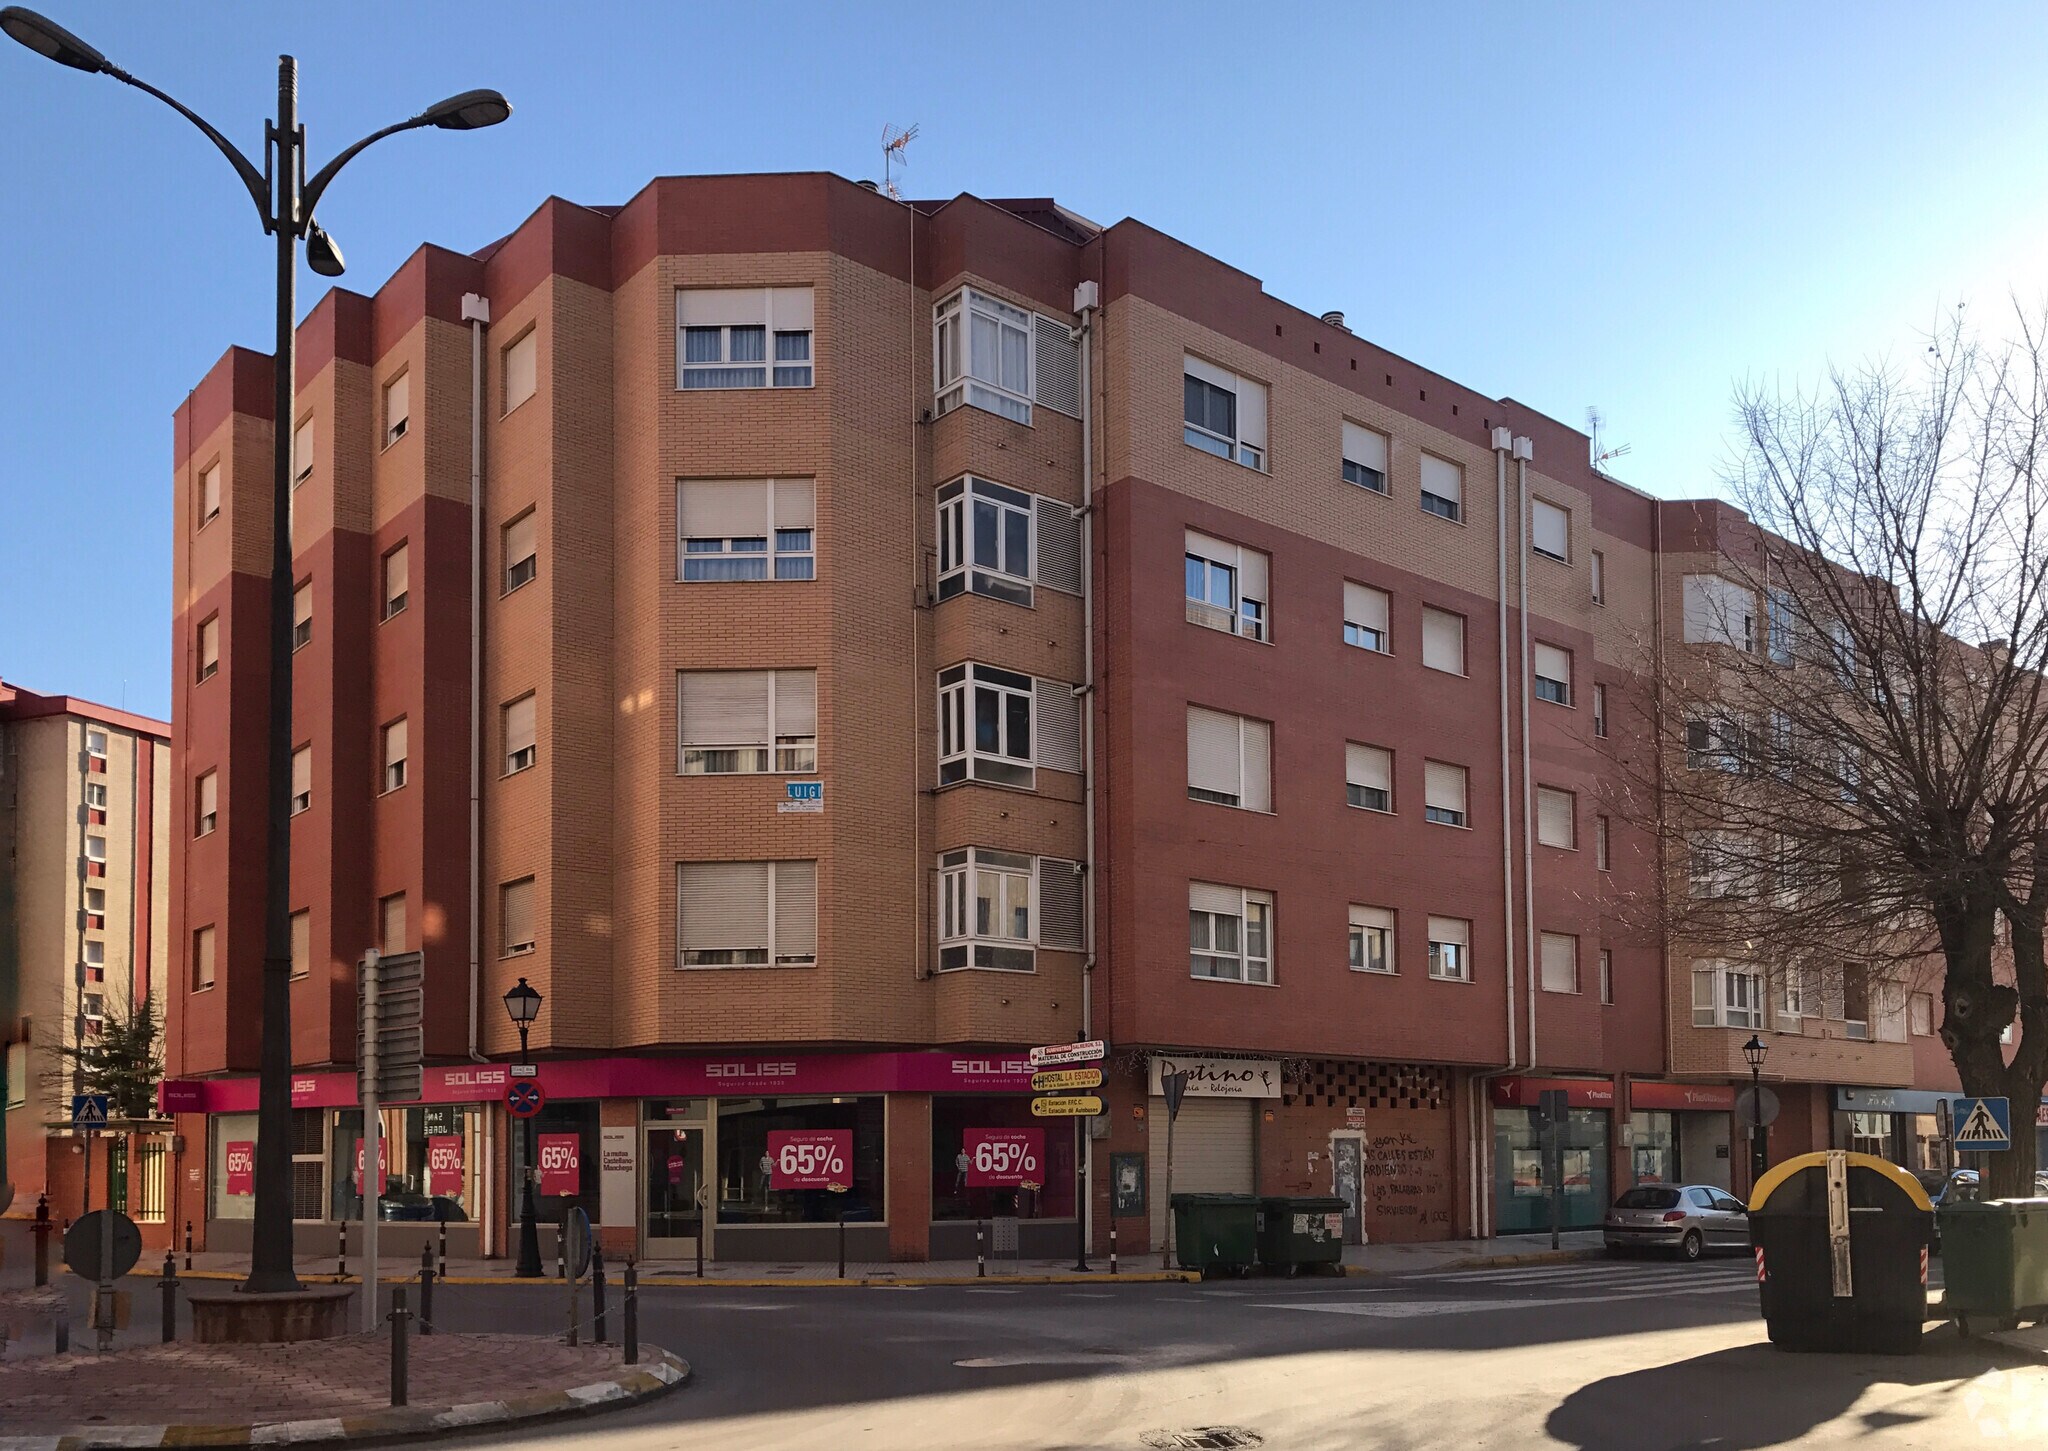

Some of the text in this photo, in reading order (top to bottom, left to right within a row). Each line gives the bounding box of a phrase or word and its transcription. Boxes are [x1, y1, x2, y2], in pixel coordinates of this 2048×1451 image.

[787, 785, 821, 798] LUIGI
[1068, 1048, 1103, 1057] CONSTRUCCIÓN
[706, 1062, 797, 1077] SOLISS
[951, 1060, 1038, 1074] SOLISS
[445, 1071, 505, 1085] SOLISS
[1045, 1073, 1063, 1082] HOSTAL
[1066, 1072, 1072, 1080] LA
[291, 1080, 316, 1092] ISS
[228, 1152, 252, 1172] 65%
[358, 1150, 386, 1170] 6%
[431, 1148, 461, 1170] 65%
[542, 1146, 578, 1169] 65%
[780, 1145, 844, 1175] 65%
[975, 1142, 1036, 1172] 65%
